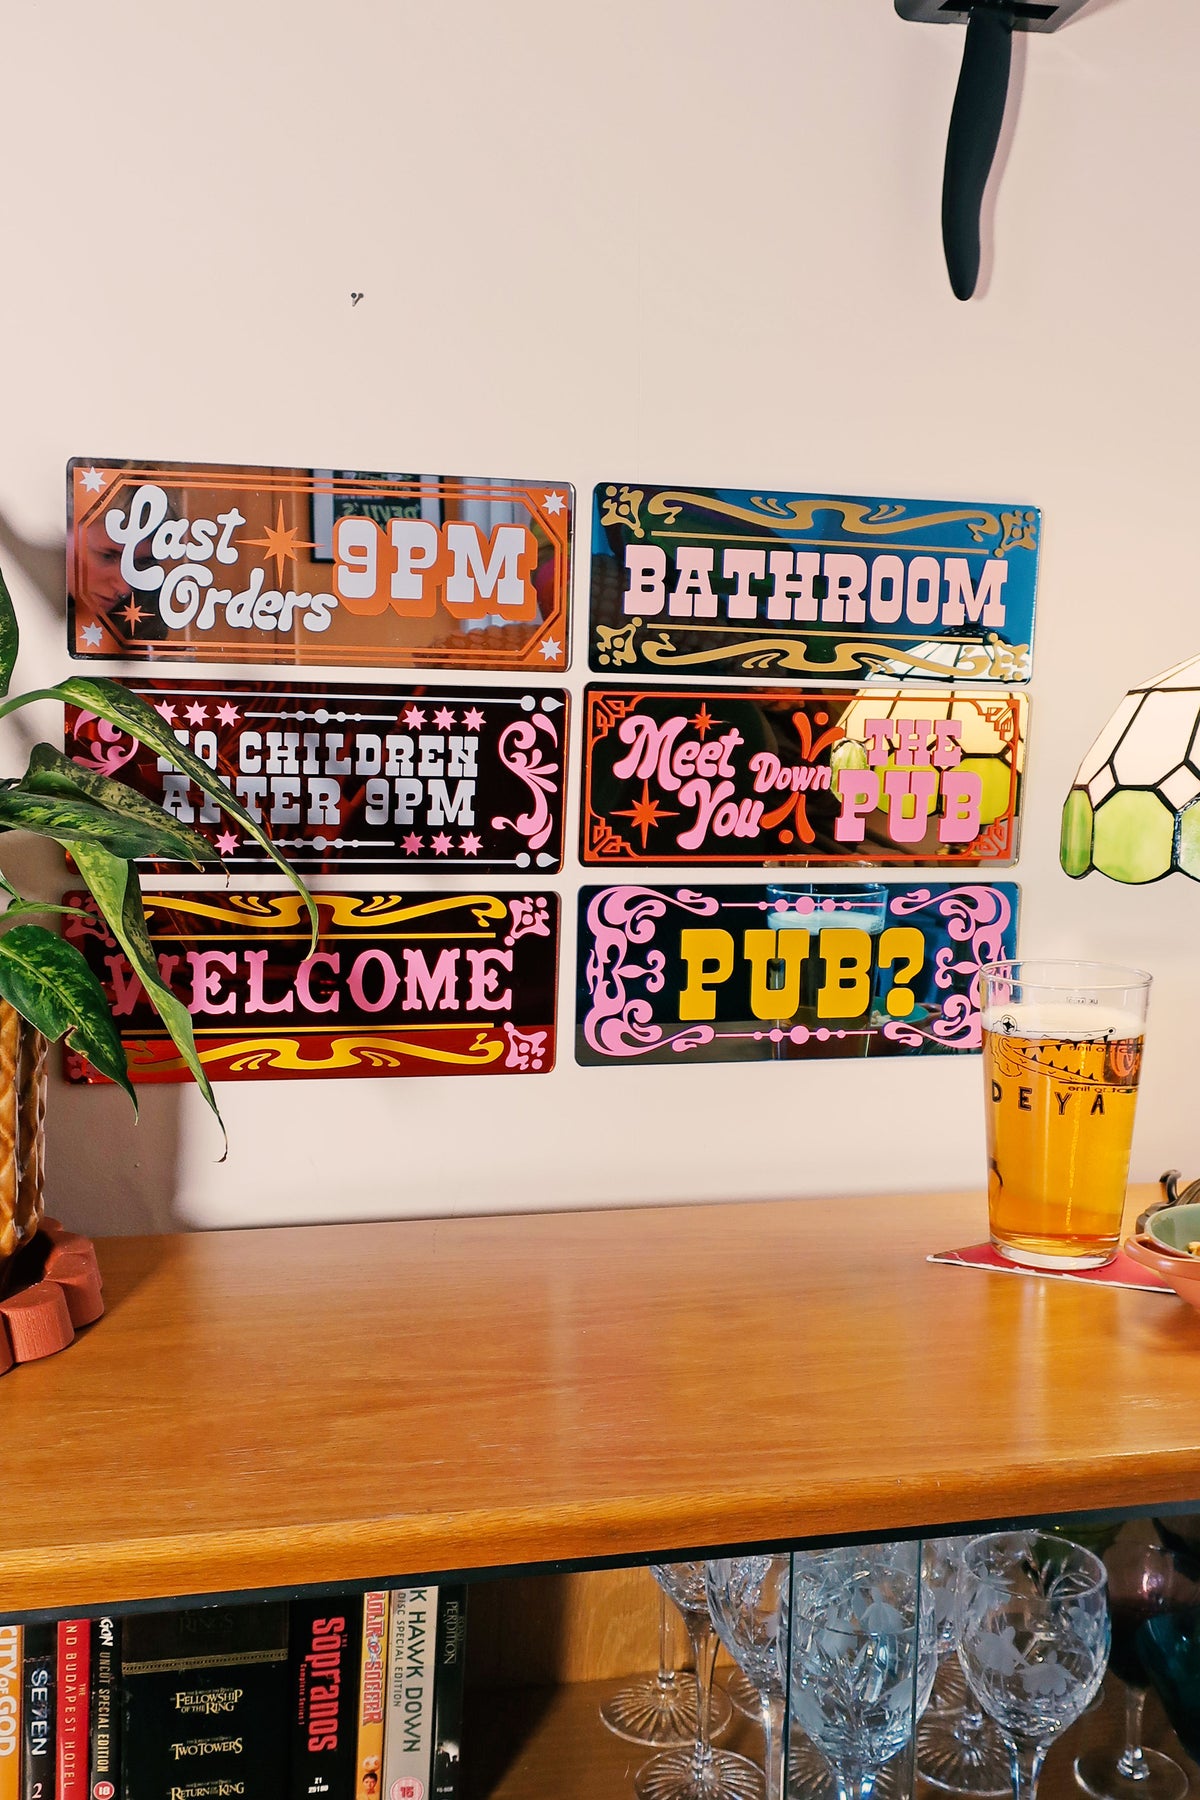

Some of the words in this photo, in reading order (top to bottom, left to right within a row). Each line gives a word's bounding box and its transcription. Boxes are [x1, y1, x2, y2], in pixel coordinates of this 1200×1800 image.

[105, 485, 246, 591] Last
[336, 518, 532, 610] 9PM
[623, 544, 1008, 627] BATHROOM
[159, 563, 338, 632] Orders
[239, 732, 479, 777] CHILDREN
[612, 715, 744, 791] Meet
[864, 719, 962, 766] THE
[749, 751, 831, 793] Down
[364, 779, 476, 826] 9PM
[676, 780, 764, 850] You
[834, 769, 982, 843] PUB
[104, 948, 513, 1016] WELCOME
[678, 927, 925, 1020] PUB?
[397, 1593, 406, 1615] DISC
[66, 1620, 77, 1645] ND
[99, 1616, 113, 1646] GON
[395, 1620, 405, 1661] SPECIAL
[406, 1611, 426, 1678] HAWK
[444, 1601, 459, 1664] PERDITION
[99, 1652, 110, 1684] UNCUT
[304, 1616, 346, 1752] Sopranos
[393, 1666, 403, 1707] EDITION
[65, 1653, 77, 1733] BUDAPEST
[98, 1688, 110, 1729] SPECIAL
[175, 1689, 243, 1709] FELLOWSHIP
[181, 1705, 191, 1713] OF
[192, 1704, 205, 1712] THE
[205, 1702, 235, 1714] RING
[363, 1661, 382, 1726] SOCCER
[0, 1696, 17, 1757] GOD
[403, 1687, 423, 1752] DOWN
[63, 1741, 75, 1788] HOTEL
[97, 1734, 109, 1772] EDITION
[171, 1743, 198, 1760] TWO
[198, 1737, 243, 1756] TOWERS
[32, 1783, 42, 1798] 2
[99, 1786, 110, 1795] 18
[171, 1787, 211, 1800] RETURN
[219, 1782, 244, 1796] KING
[401, 1787, 414, 1798] 15
